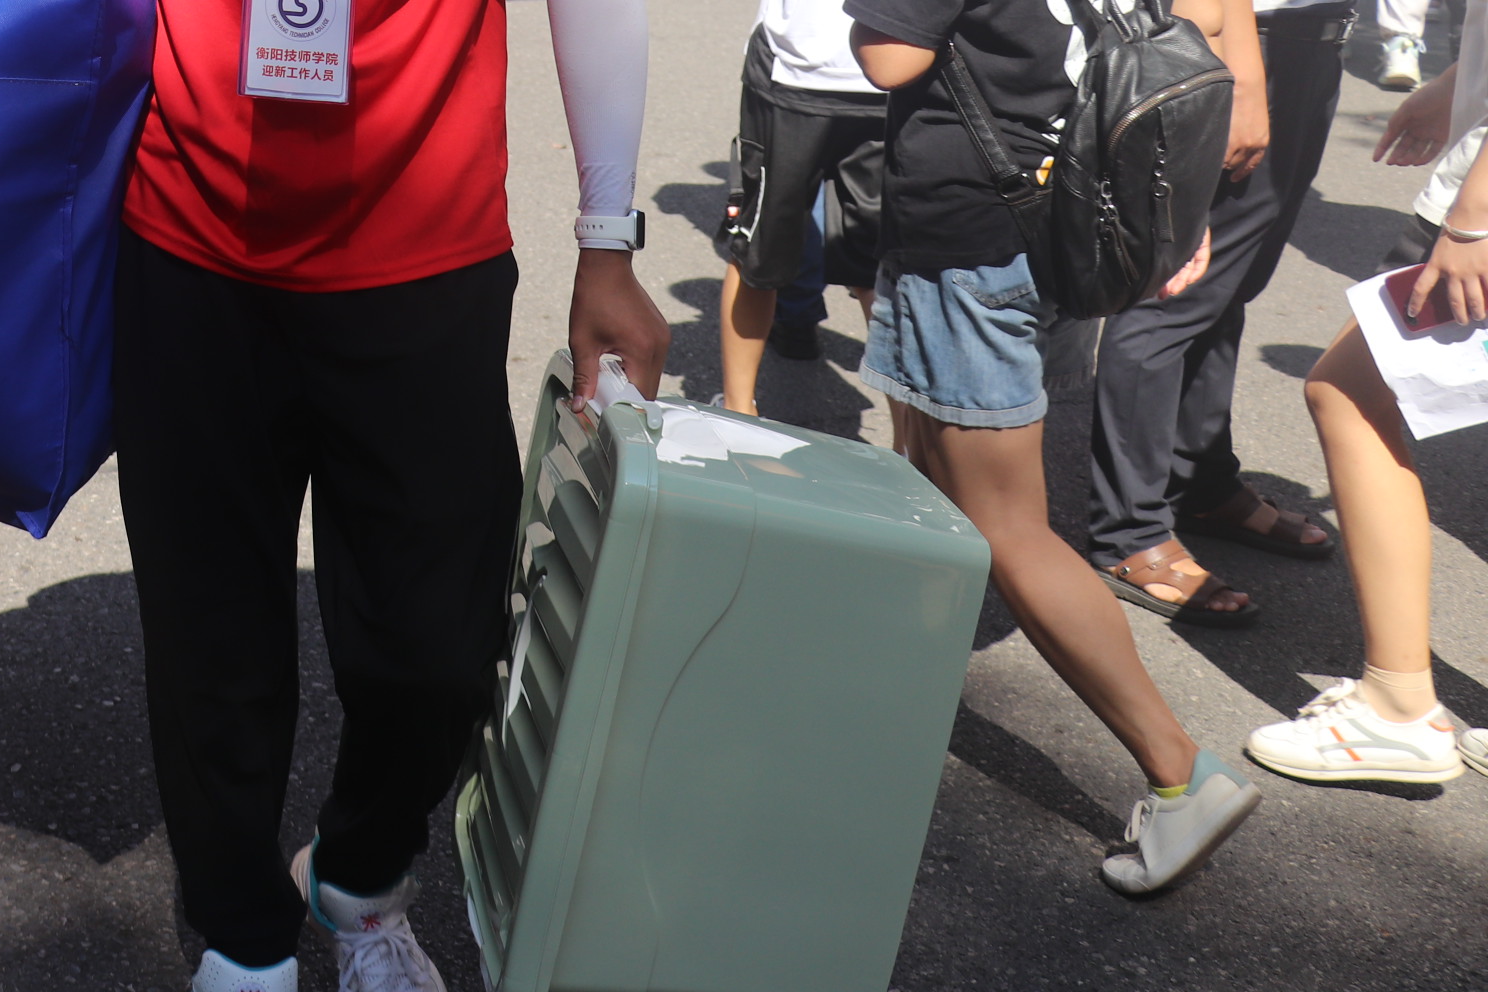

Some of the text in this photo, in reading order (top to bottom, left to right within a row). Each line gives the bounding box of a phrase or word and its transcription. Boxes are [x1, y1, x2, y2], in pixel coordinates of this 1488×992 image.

[256, 47, 339, 66] 衡阳技师学院
[262, 64, 334, 82] 迎新工作人员
